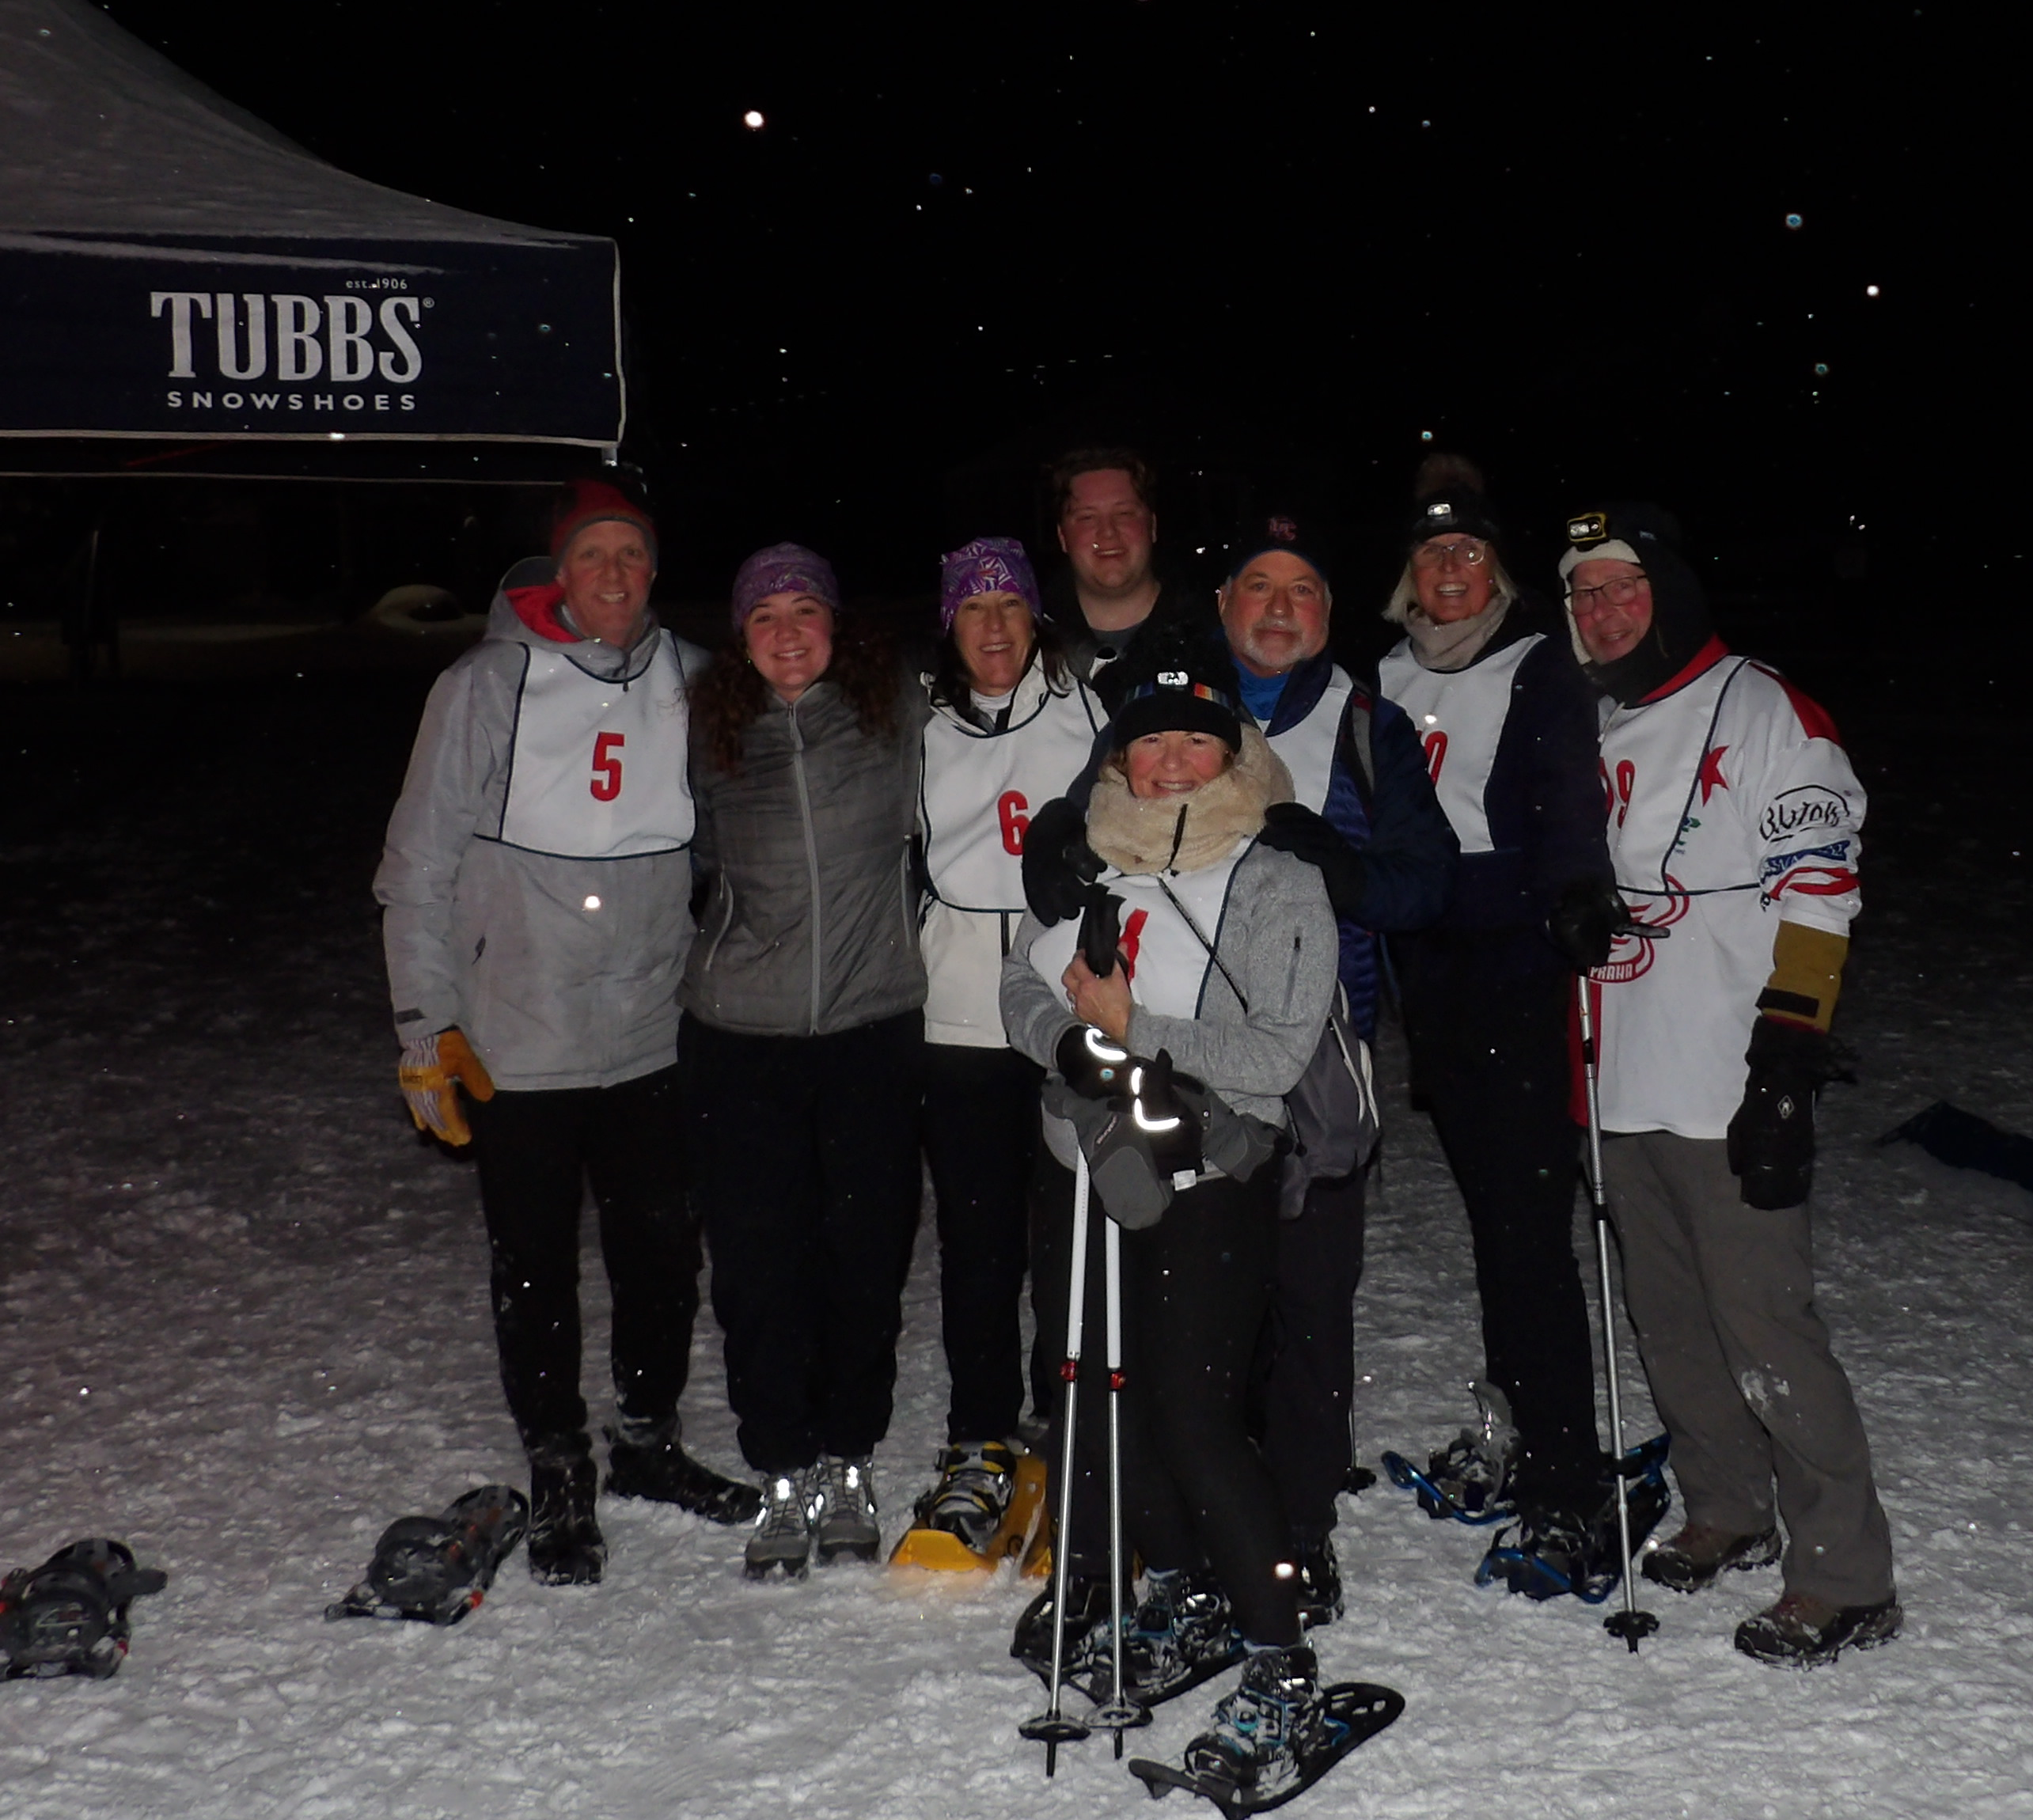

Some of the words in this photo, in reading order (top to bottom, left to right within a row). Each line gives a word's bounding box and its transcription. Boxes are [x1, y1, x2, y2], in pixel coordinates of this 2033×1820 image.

[377, 278, 408, 290] 1906
[168, 391, 415, 411] SNOWSHOES
[590, 731, 625, 802] 5
[998, 790, 1031, 856] 6
